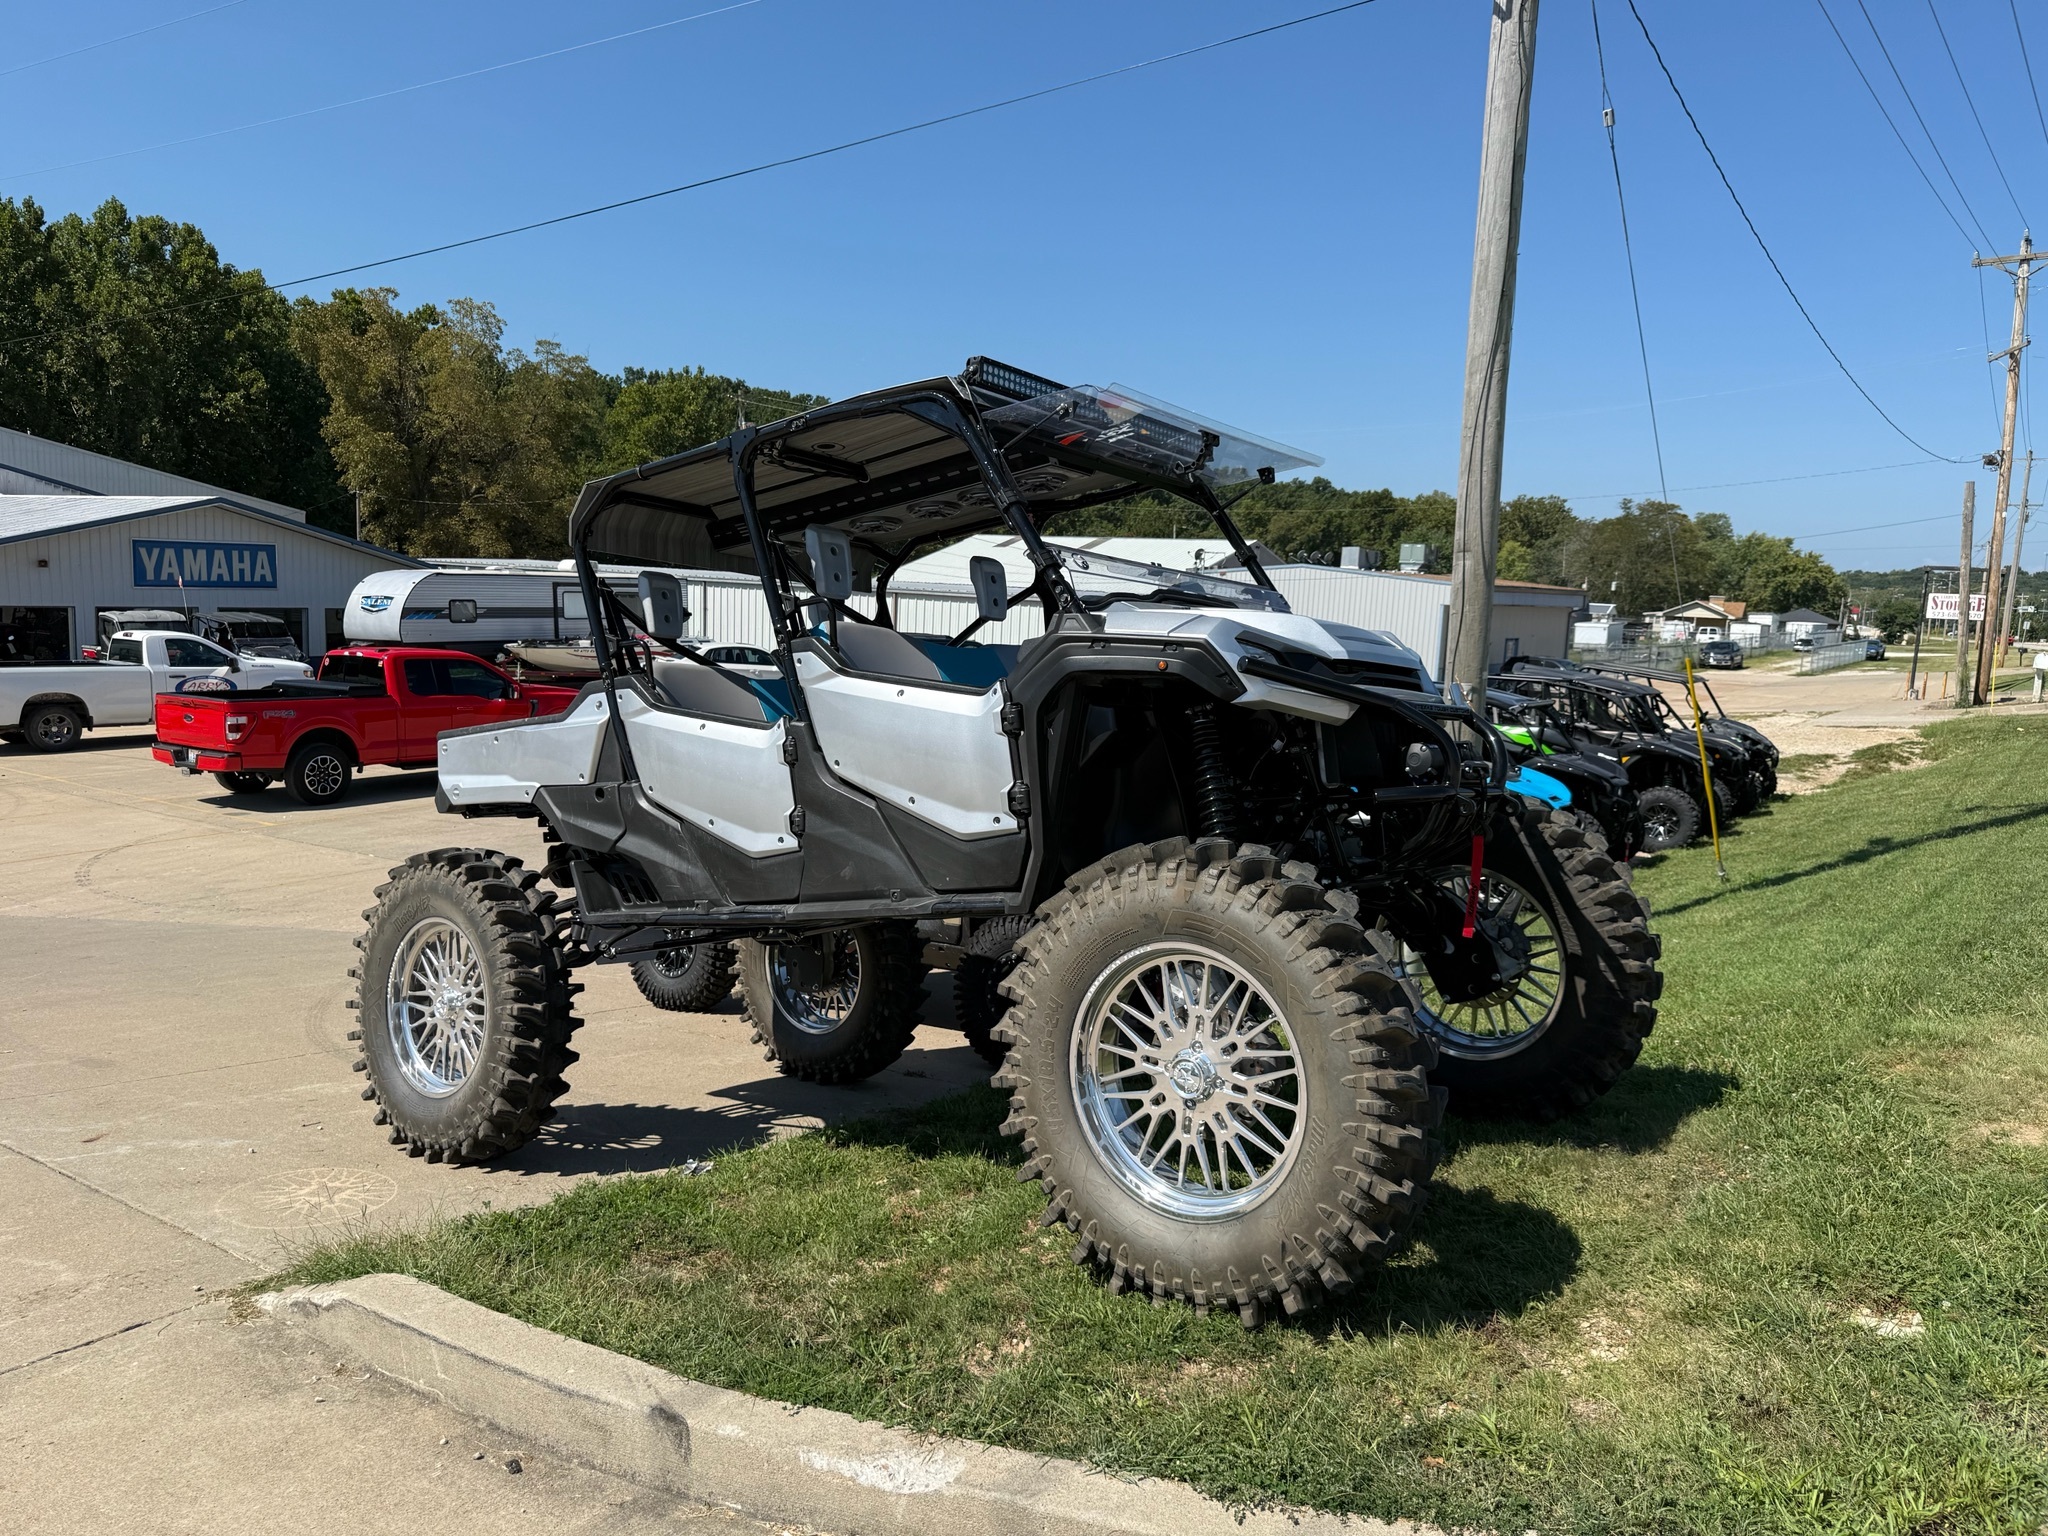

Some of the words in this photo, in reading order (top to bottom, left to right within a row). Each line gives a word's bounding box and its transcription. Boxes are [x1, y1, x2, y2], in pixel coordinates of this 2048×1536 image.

[138, 547, 273, 582] YAMAHA
[360, 597, 393, 606] SALEM
[1931, 595, 1985, 612] STORGE
